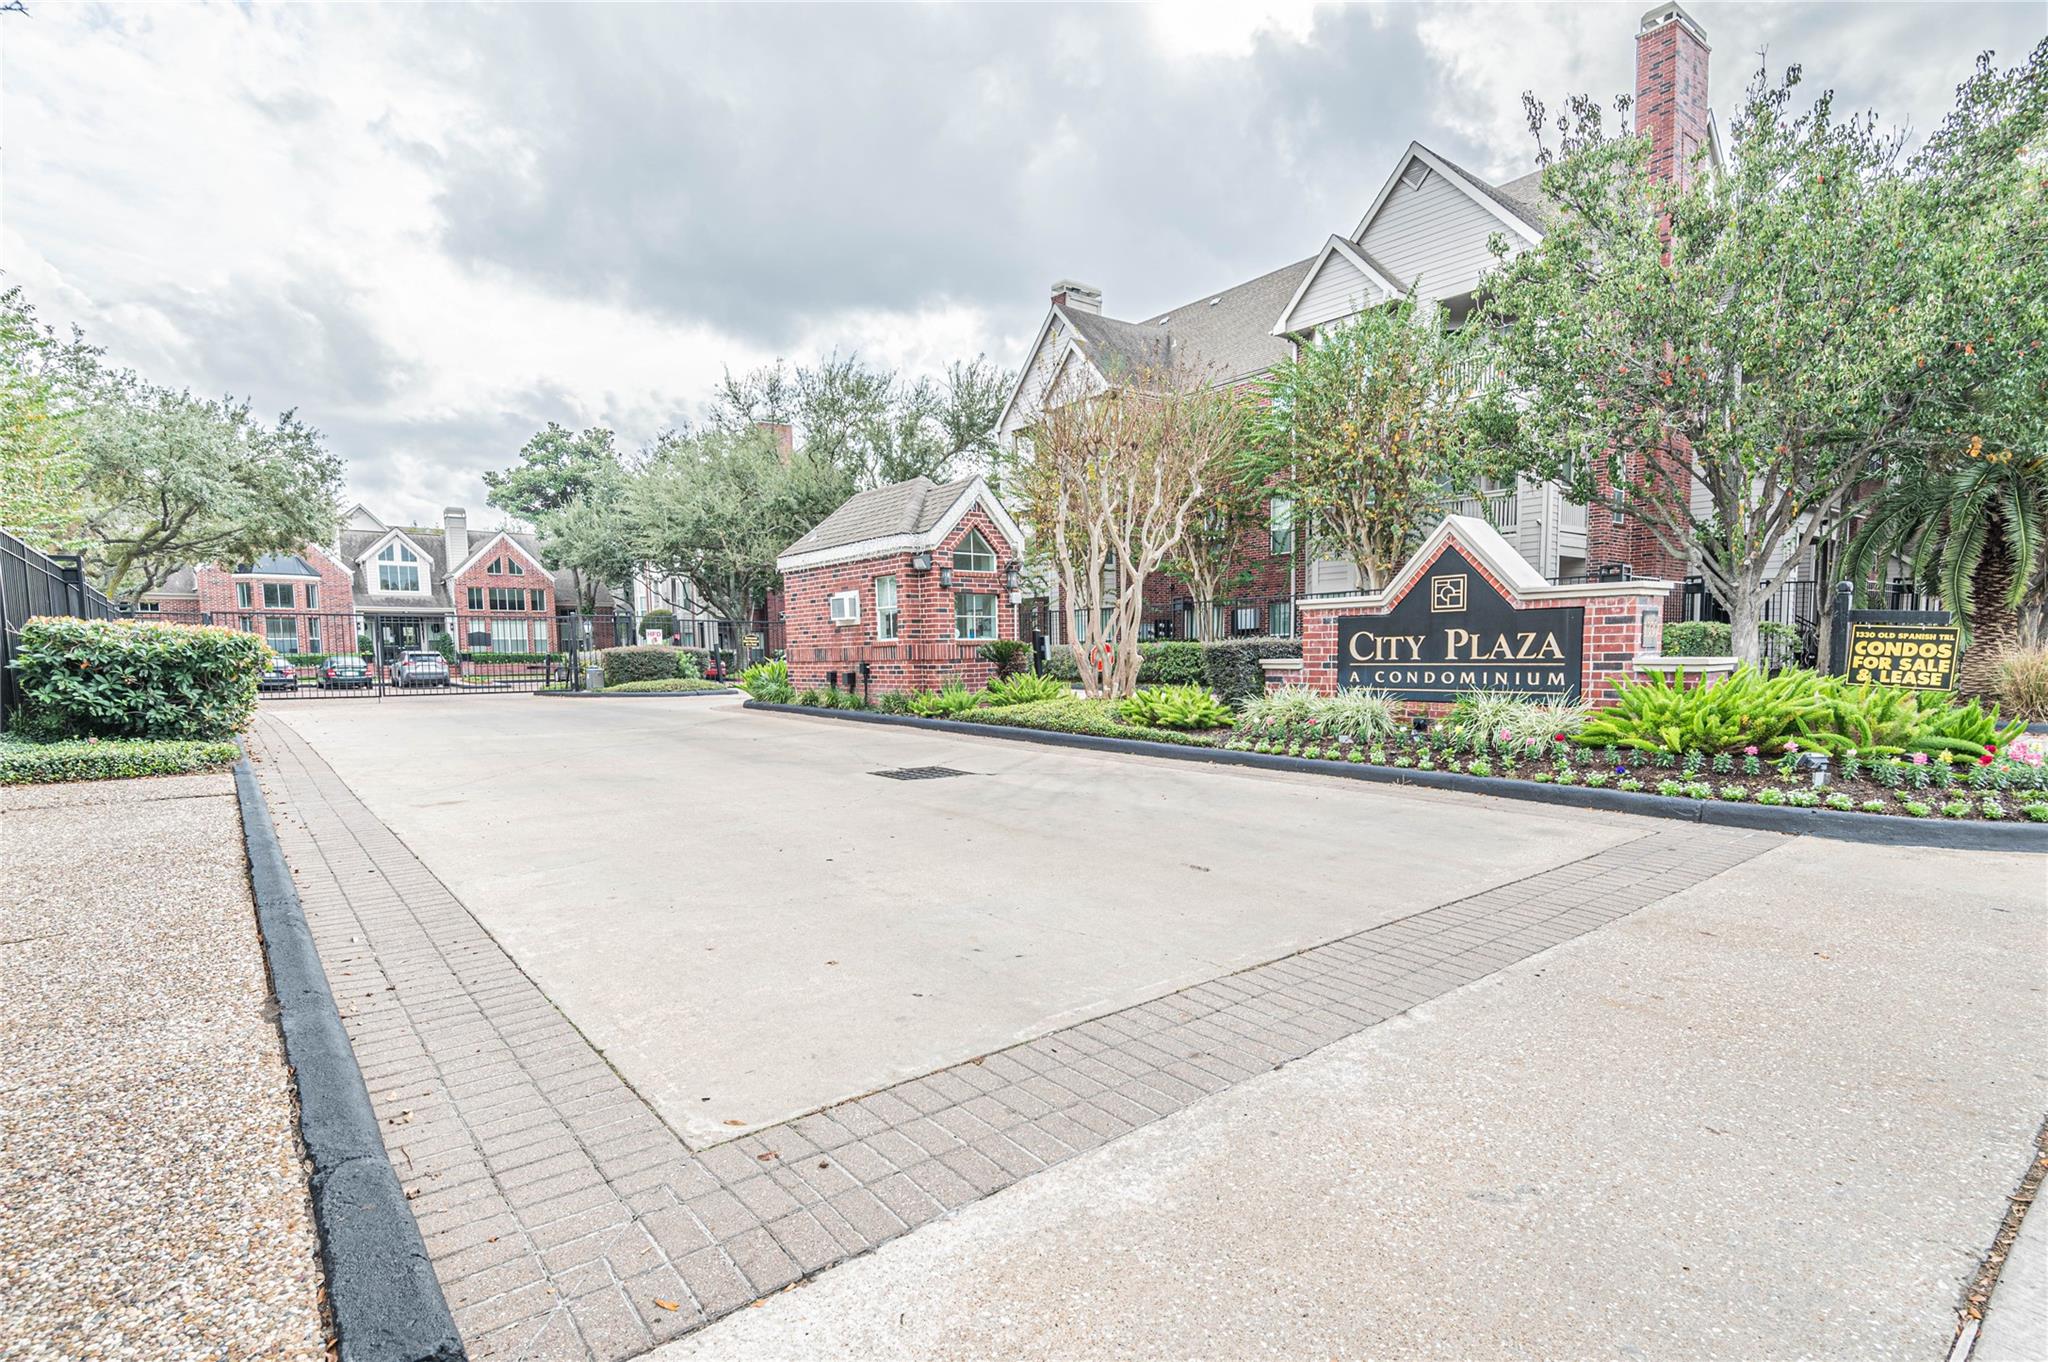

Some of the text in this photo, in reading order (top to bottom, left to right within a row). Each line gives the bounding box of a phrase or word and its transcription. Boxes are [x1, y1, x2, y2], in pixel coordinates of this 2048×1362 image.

[1349, 628, 1566, 661] CITY PLAZA
[1898, 632, 1937, 640] SPANISH
[1940, 633, 1956, 641] TRL
[1854, 640, 1953, 659] CONDOS
[1852, 655, 1950, 673] FOR SALE
[1349, 670, 1566, 686] A CONDOMINIUM
[1856, 669, 1943, 686] & LEASE
